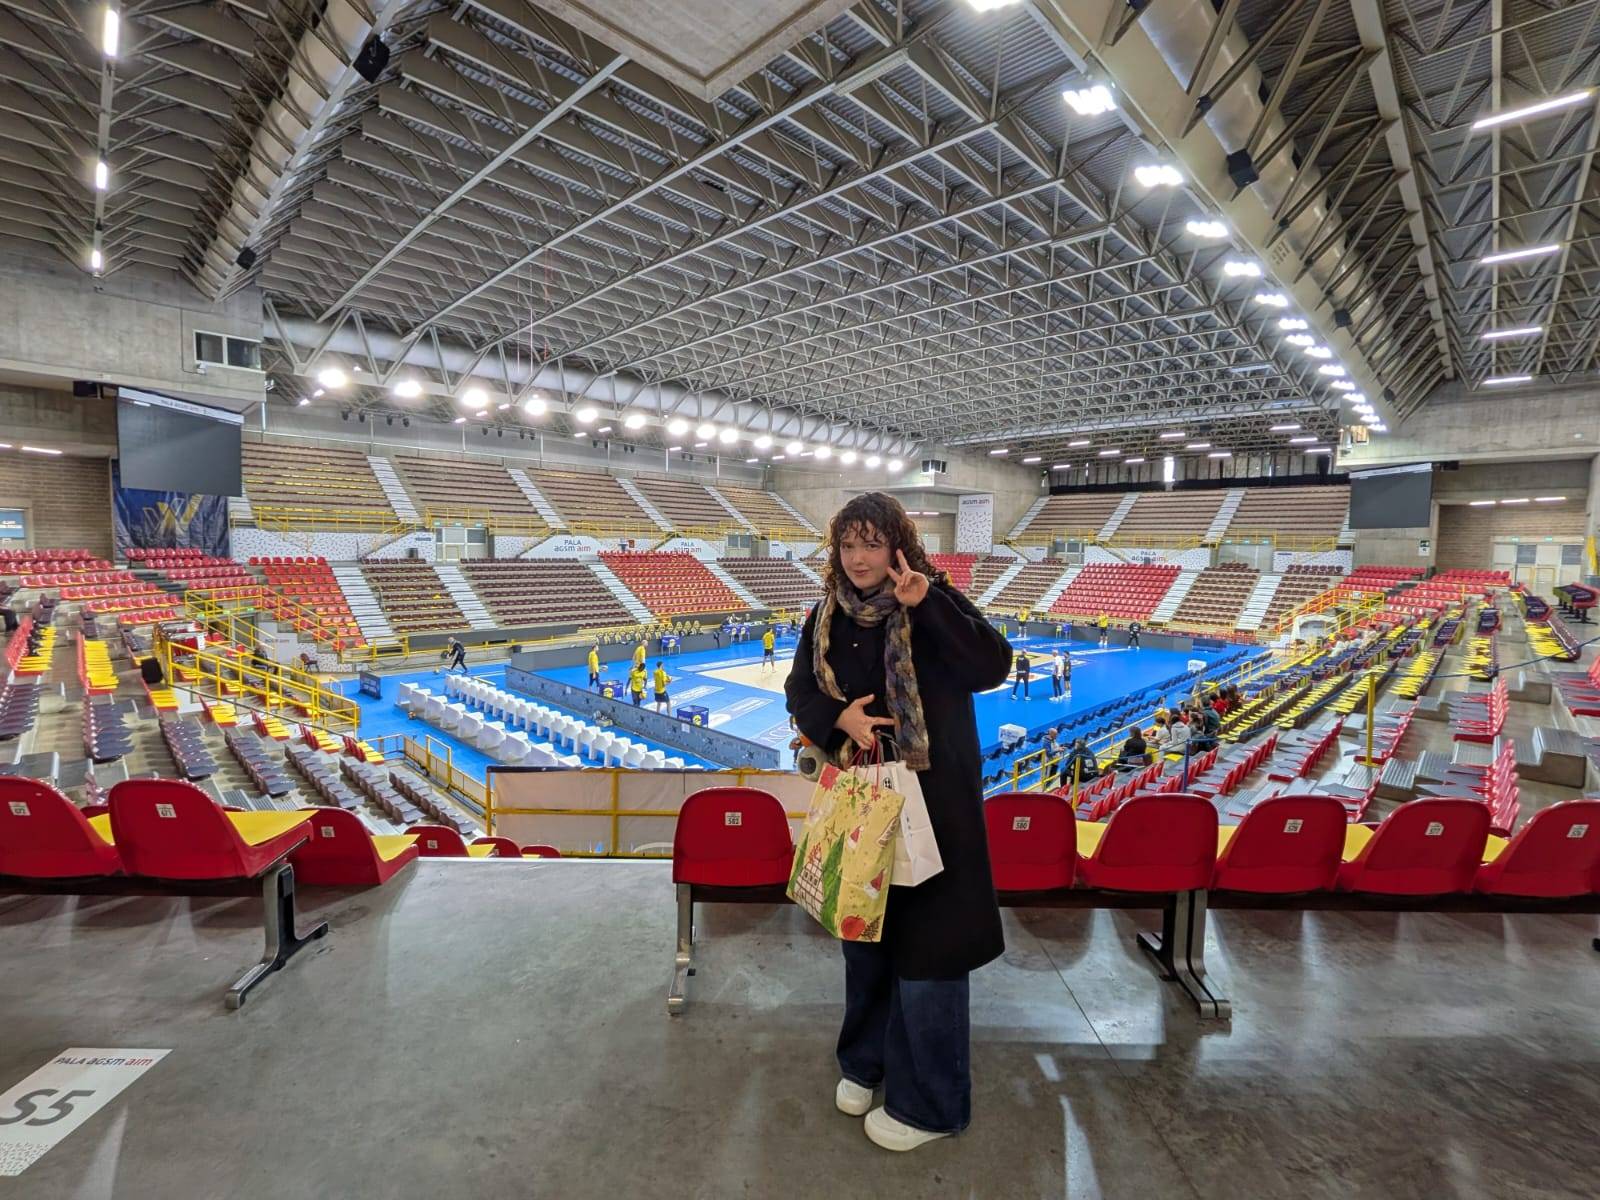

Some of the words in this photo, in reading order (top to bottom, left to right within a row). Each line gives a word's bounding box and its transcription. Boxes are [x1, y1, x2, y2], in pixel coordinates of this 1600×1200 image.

[54, 1056, 86, 1065] PALA
[125, 1057, 153, 1067] aim
[0, 1088, 96, 1126] S5
